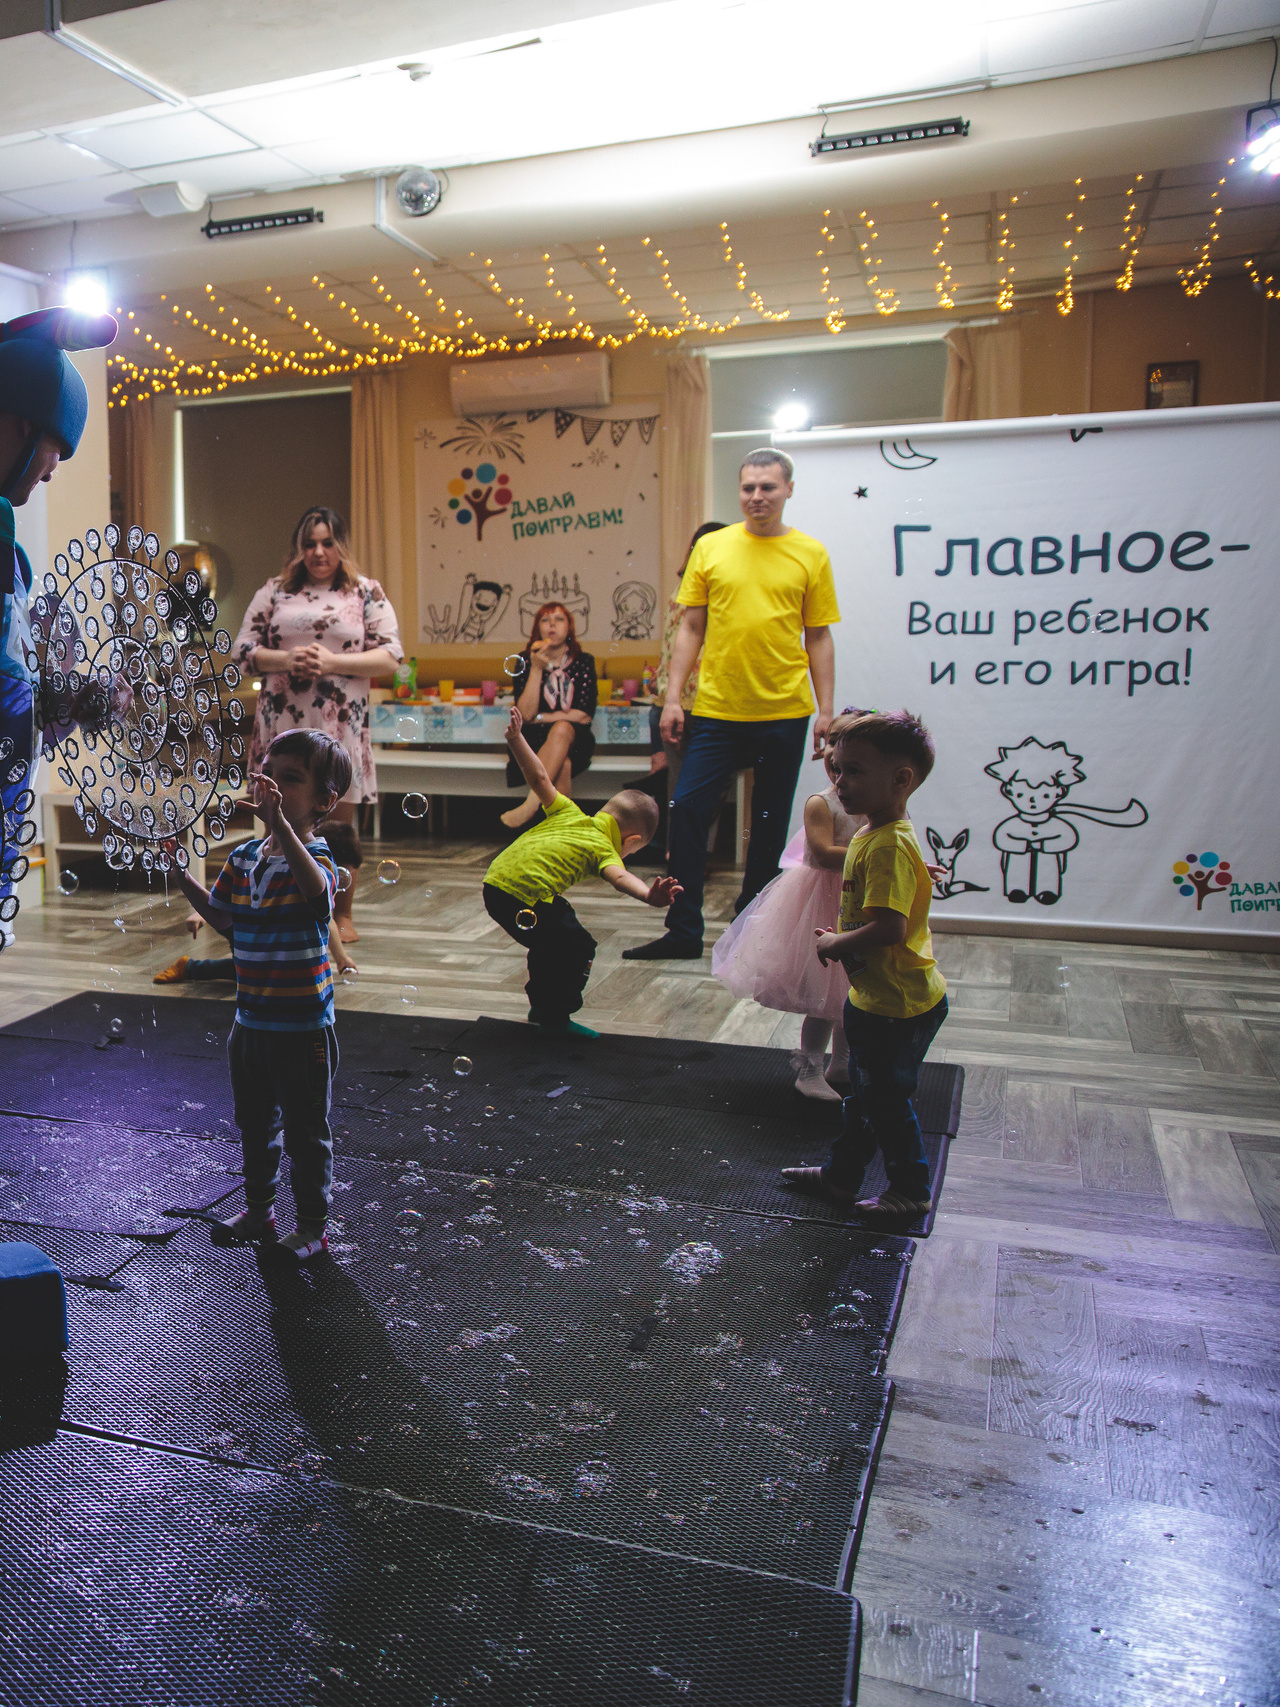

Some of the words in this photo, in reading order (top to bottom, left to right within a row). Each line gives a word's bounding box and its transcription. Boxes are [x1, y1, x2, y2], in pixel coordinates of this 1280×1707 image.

[511, 492, 575, 519] ДАВАЙ
[512, 508, 624, 541] ПОИГРАЕМ!
[893, 523, 1251, 577] Главное-
[908, 600, 995, 636] Ваш
[1013, 597, 1211, 645] ребенок
[930, 660, 956, 686] и
[974, 660, 1052, 686] его
[1070, 646, 1192, 697] игра!
[1229, 881, 1280, 897] ДАВА
